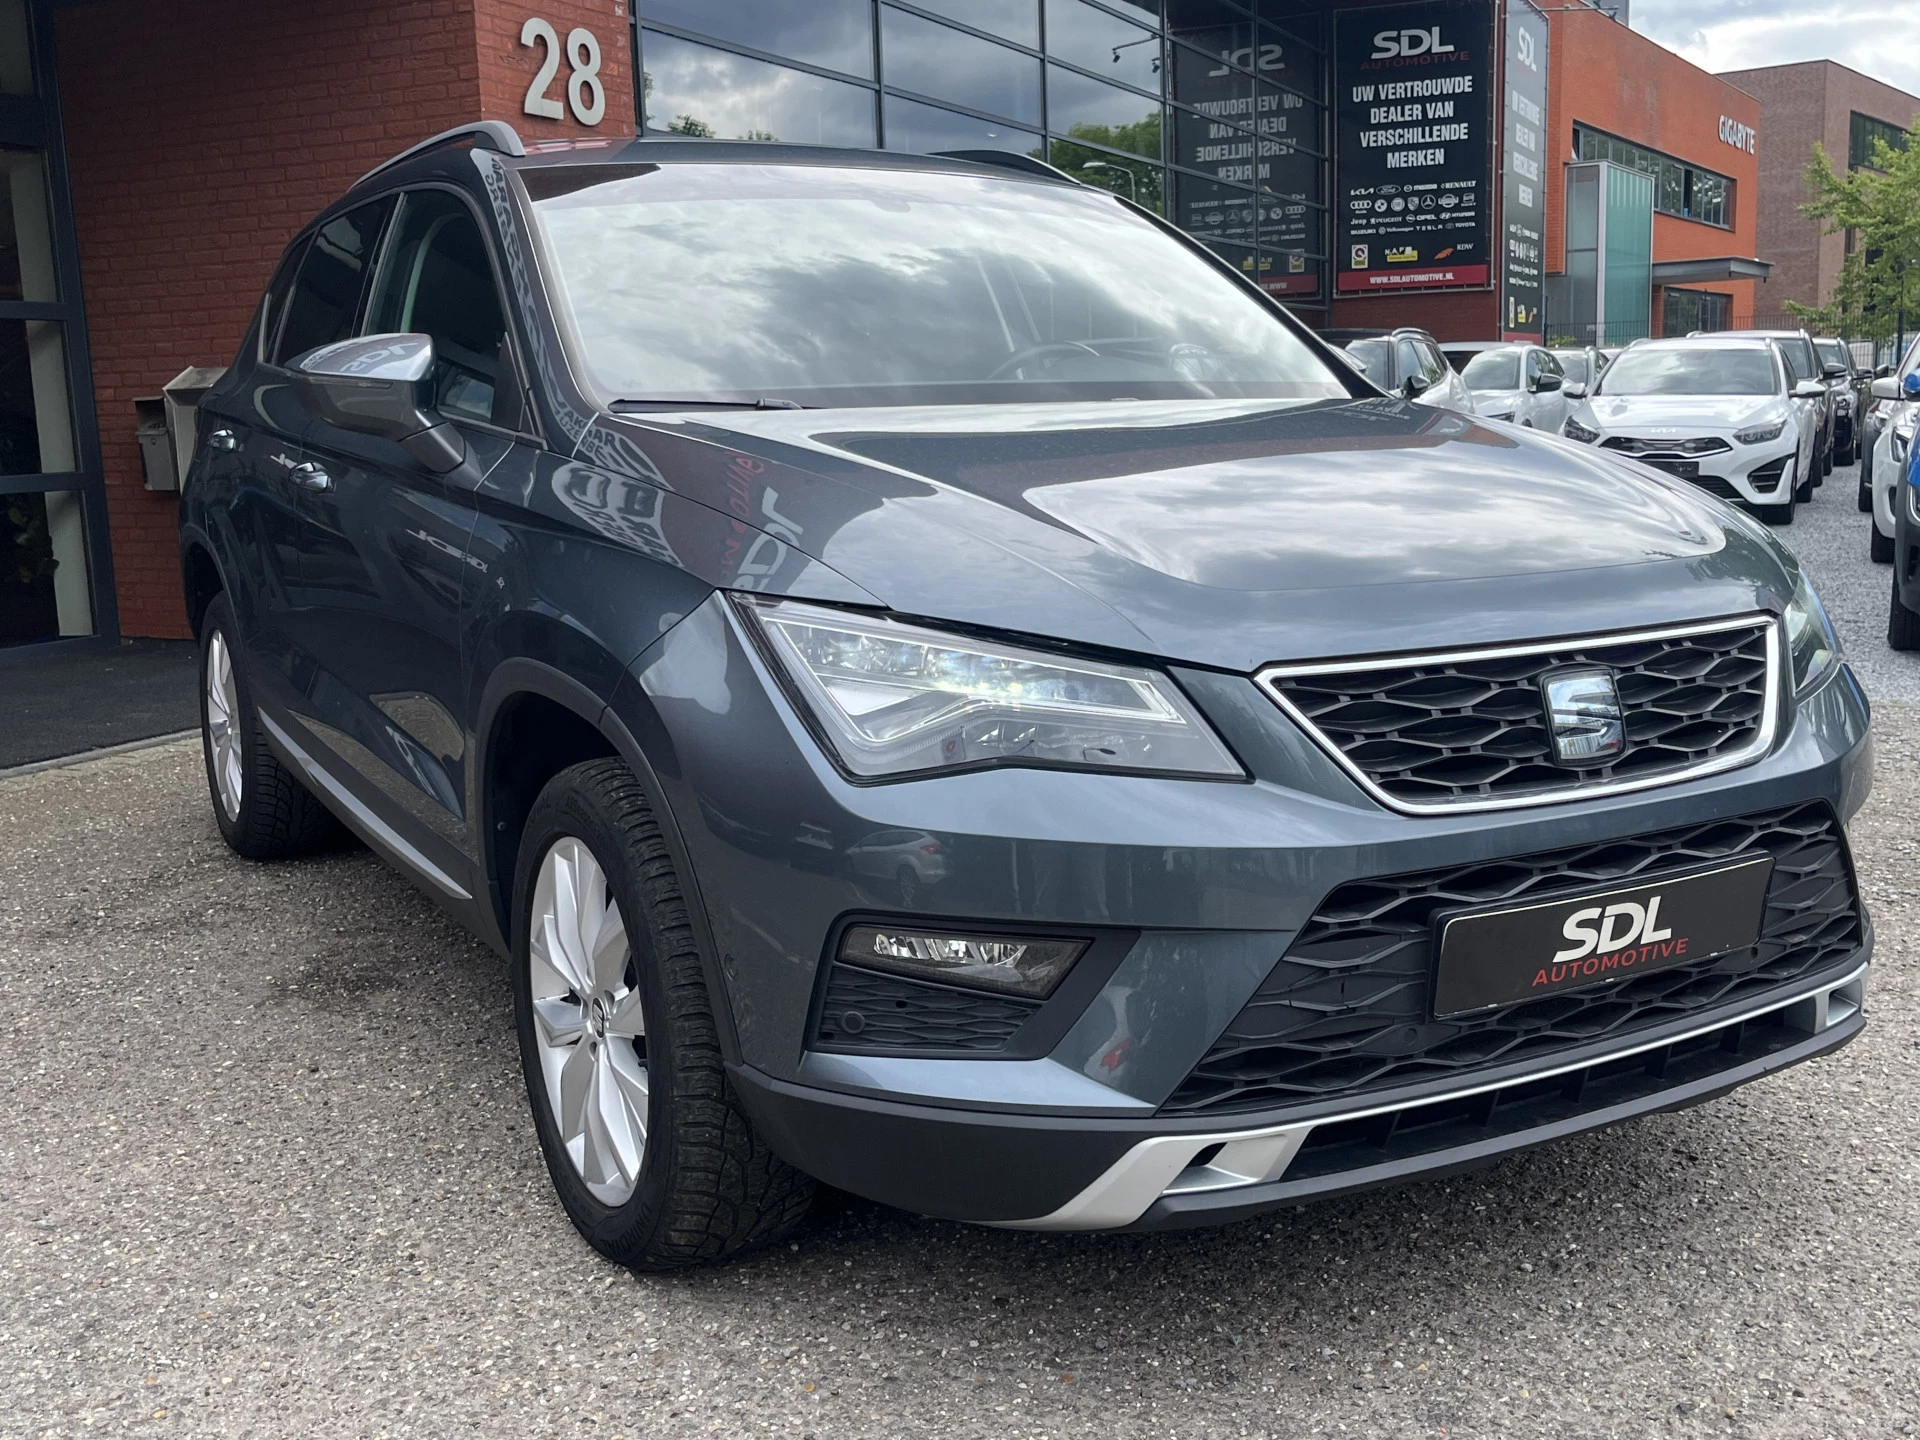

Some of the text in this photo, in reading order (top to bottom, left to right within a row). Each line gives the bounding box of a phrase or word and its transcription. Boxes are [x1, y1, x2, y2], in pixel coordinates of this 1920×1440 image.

[1371, 26, 1455, 59] SDL
[1517, 26, 1537, 72] SDL
[521, 17, 605, 126] 28
[1360, 51, 1470, 70] AUTOMOTIVE
[1352, 75, 1473, 103] UW VERTROUWDE
[1370, 101, 1454, 124] DEALER VAN
[1360, 122, 1468, 148] VERSCHILLENDE
[1718, 115, 1756, 155] GIGABYTE
[1387, 148, 1444, 169] MERKEN
[1445, 180, 1477, 189] RENAULT
[1457, 243, 1474, 251] RDW
[1370, 272, 1454, 284] WWW.SDLAUTOMOTIVE.NL
[1552, 895, 1672, 963] SDL
[1531, 938, 1689, 988] AUTOMOTIVE
